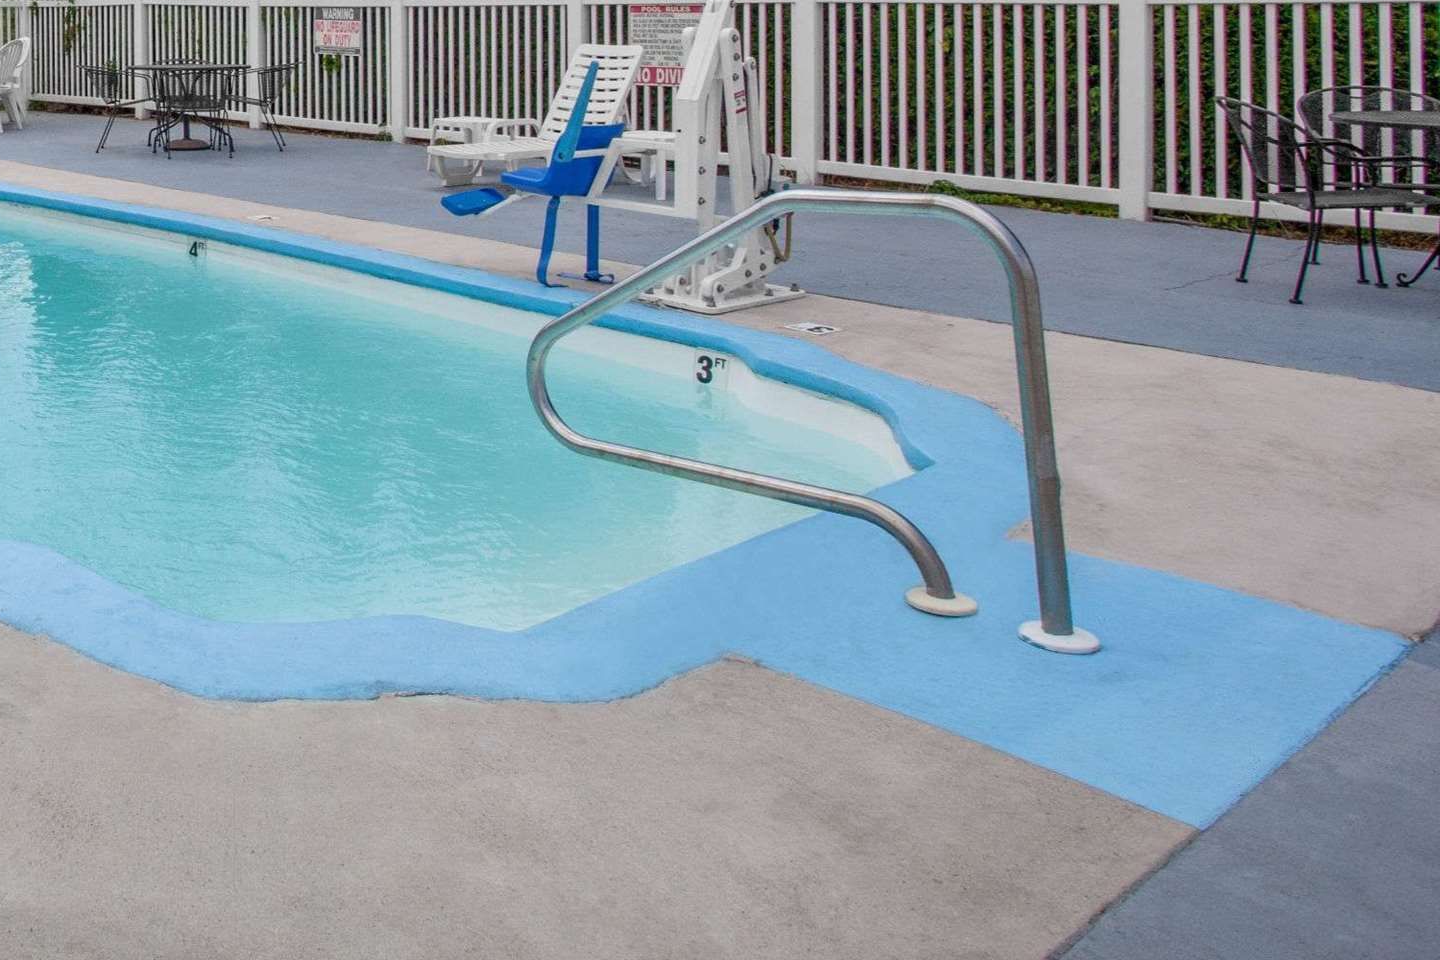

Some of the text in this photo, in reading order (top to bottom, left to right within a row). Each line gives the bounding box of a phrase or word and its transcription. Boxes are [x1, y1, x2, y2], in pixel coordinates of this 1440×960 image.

[321, 7, 354, 20] WARNING
[656, 68, 681, 84] DIVI
[696, 355, 727, 384] 3 FT
